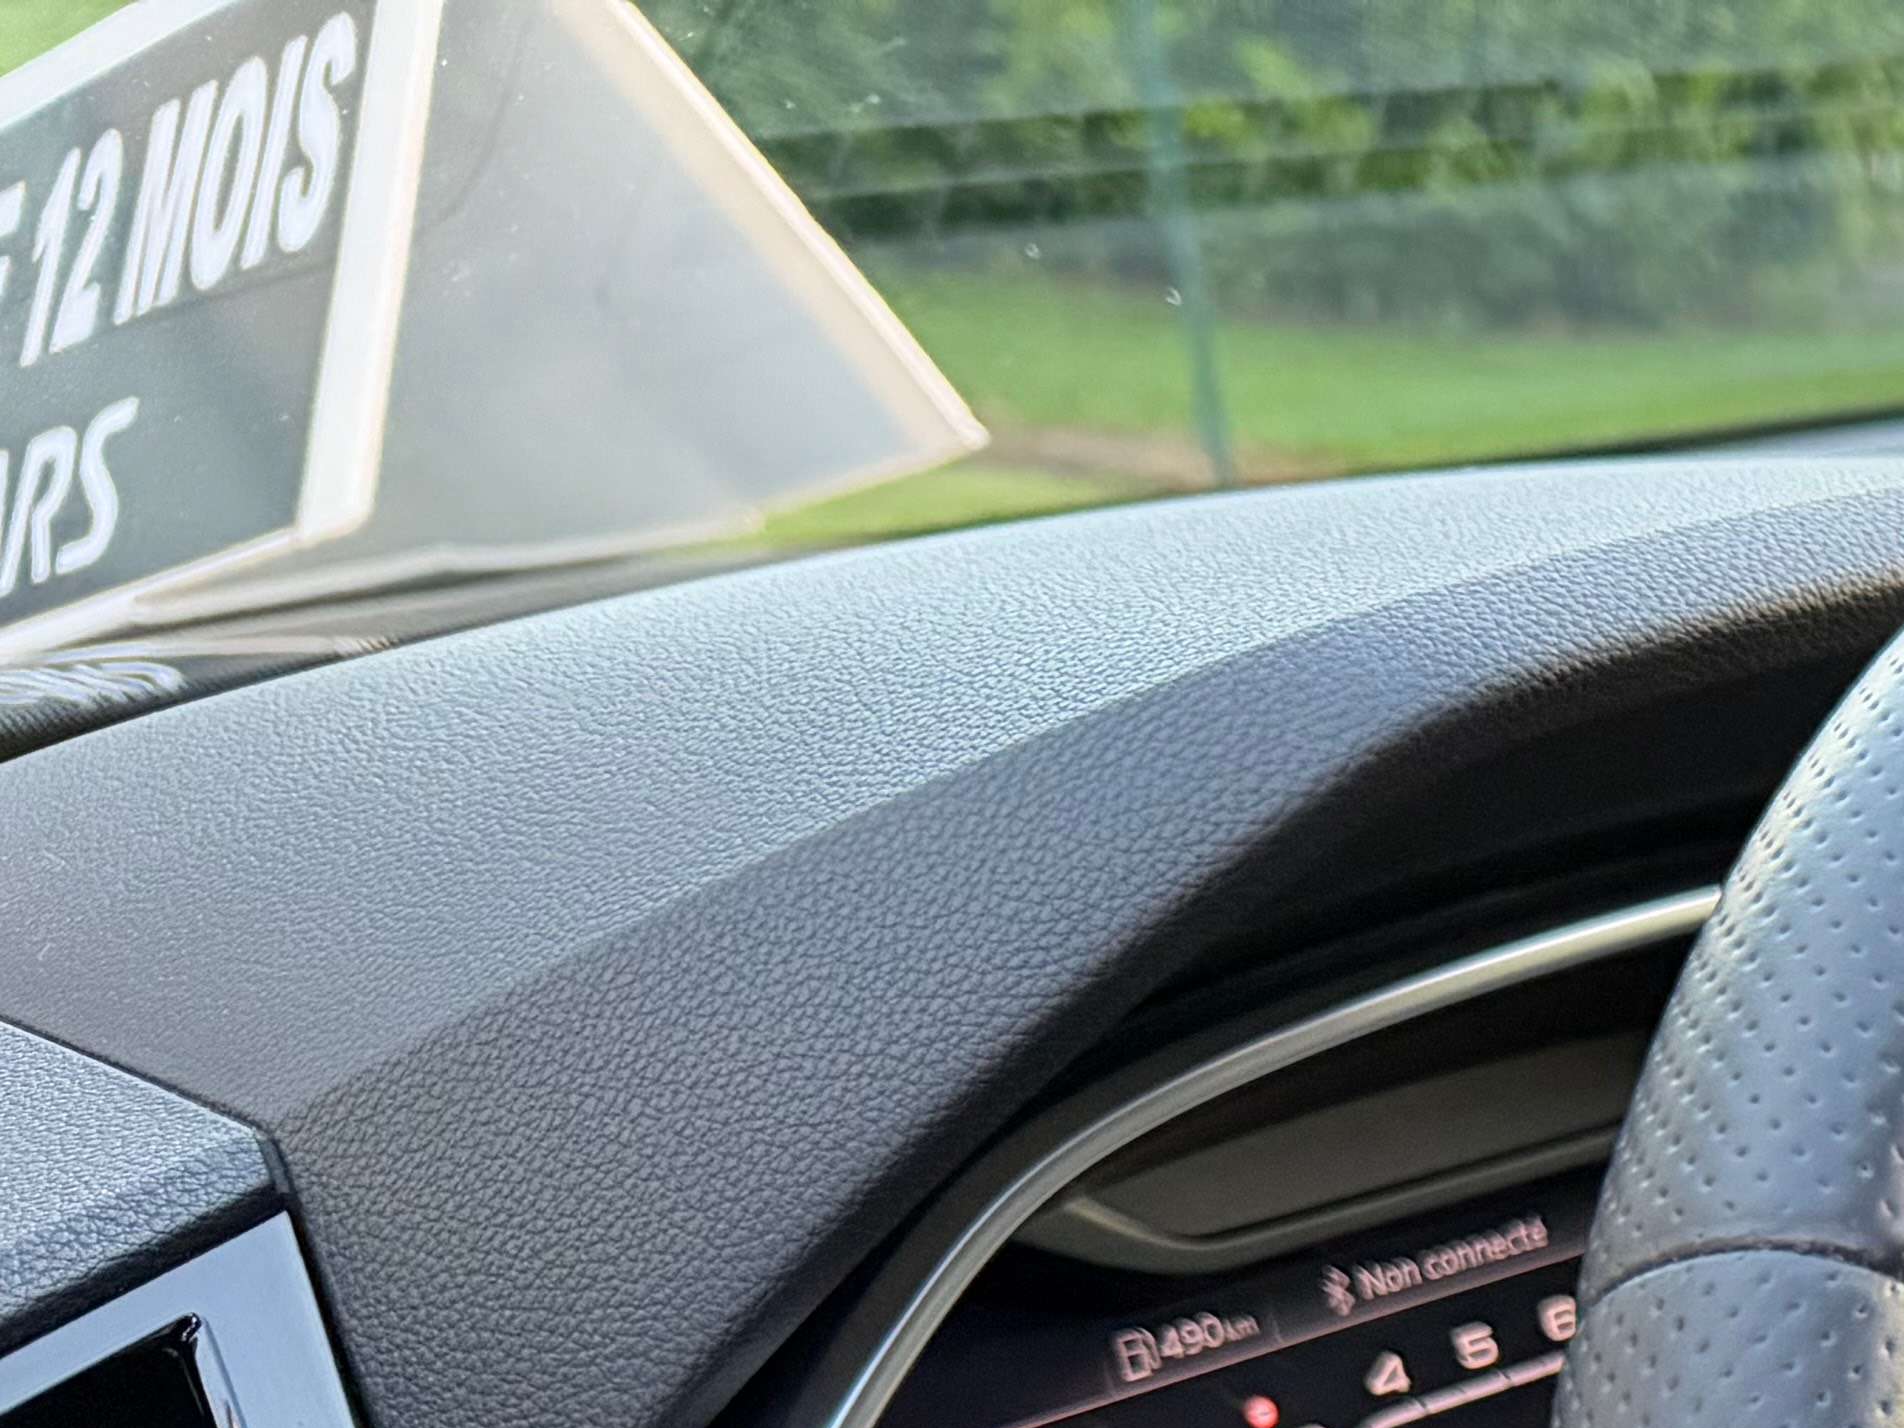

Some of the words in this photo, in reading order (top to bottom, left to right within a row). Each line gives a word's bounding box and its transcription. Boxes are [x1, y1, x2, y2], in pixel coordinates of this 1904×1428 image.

[20, 127, 124, 366] 12
[113, 12, 358, 326] MOIS
[0, 396, 140, 600] RS
[1158, 1310, 1225, 1360] 490
[1536, 1294, 1577, 1342] 6
[1450, 1320, 1500, 1370] 5
[1364, 1350, 1412, 1396] 4
